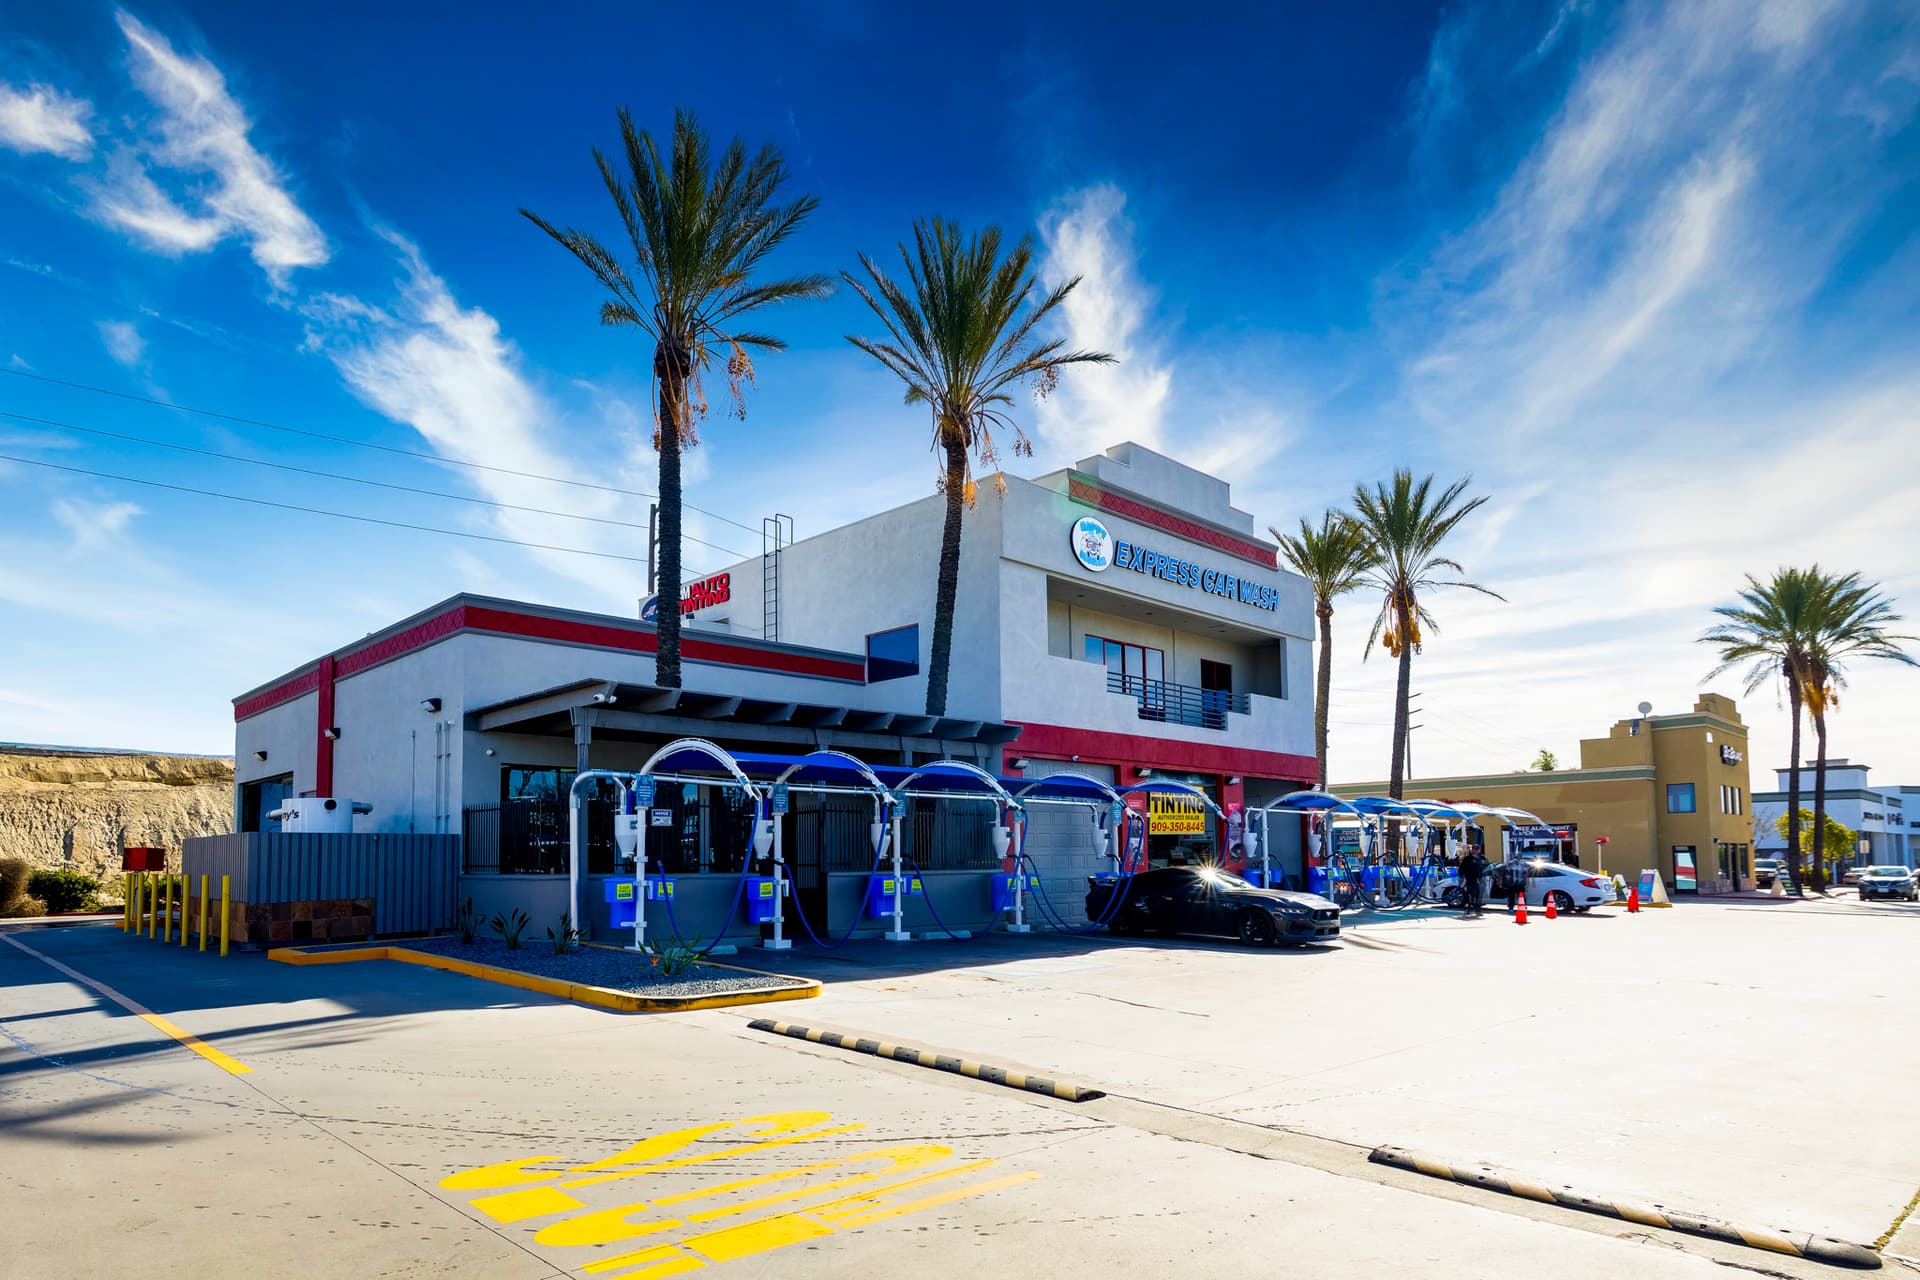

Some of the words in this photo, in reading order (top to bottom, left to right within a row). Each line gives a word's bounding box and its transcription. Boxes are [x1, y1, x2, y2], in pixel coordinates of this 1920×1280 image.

[690, 573, 730, 598] AUTO
[1115, 540, 1201, 588] EXPRESS
[1202, 568, 1237, 600] CAR
[1237, 578, 1280, 611] WASH
[1151, 796, 1205, 814] TINTING
[437, 1110, 1046, 1280] SLOW
